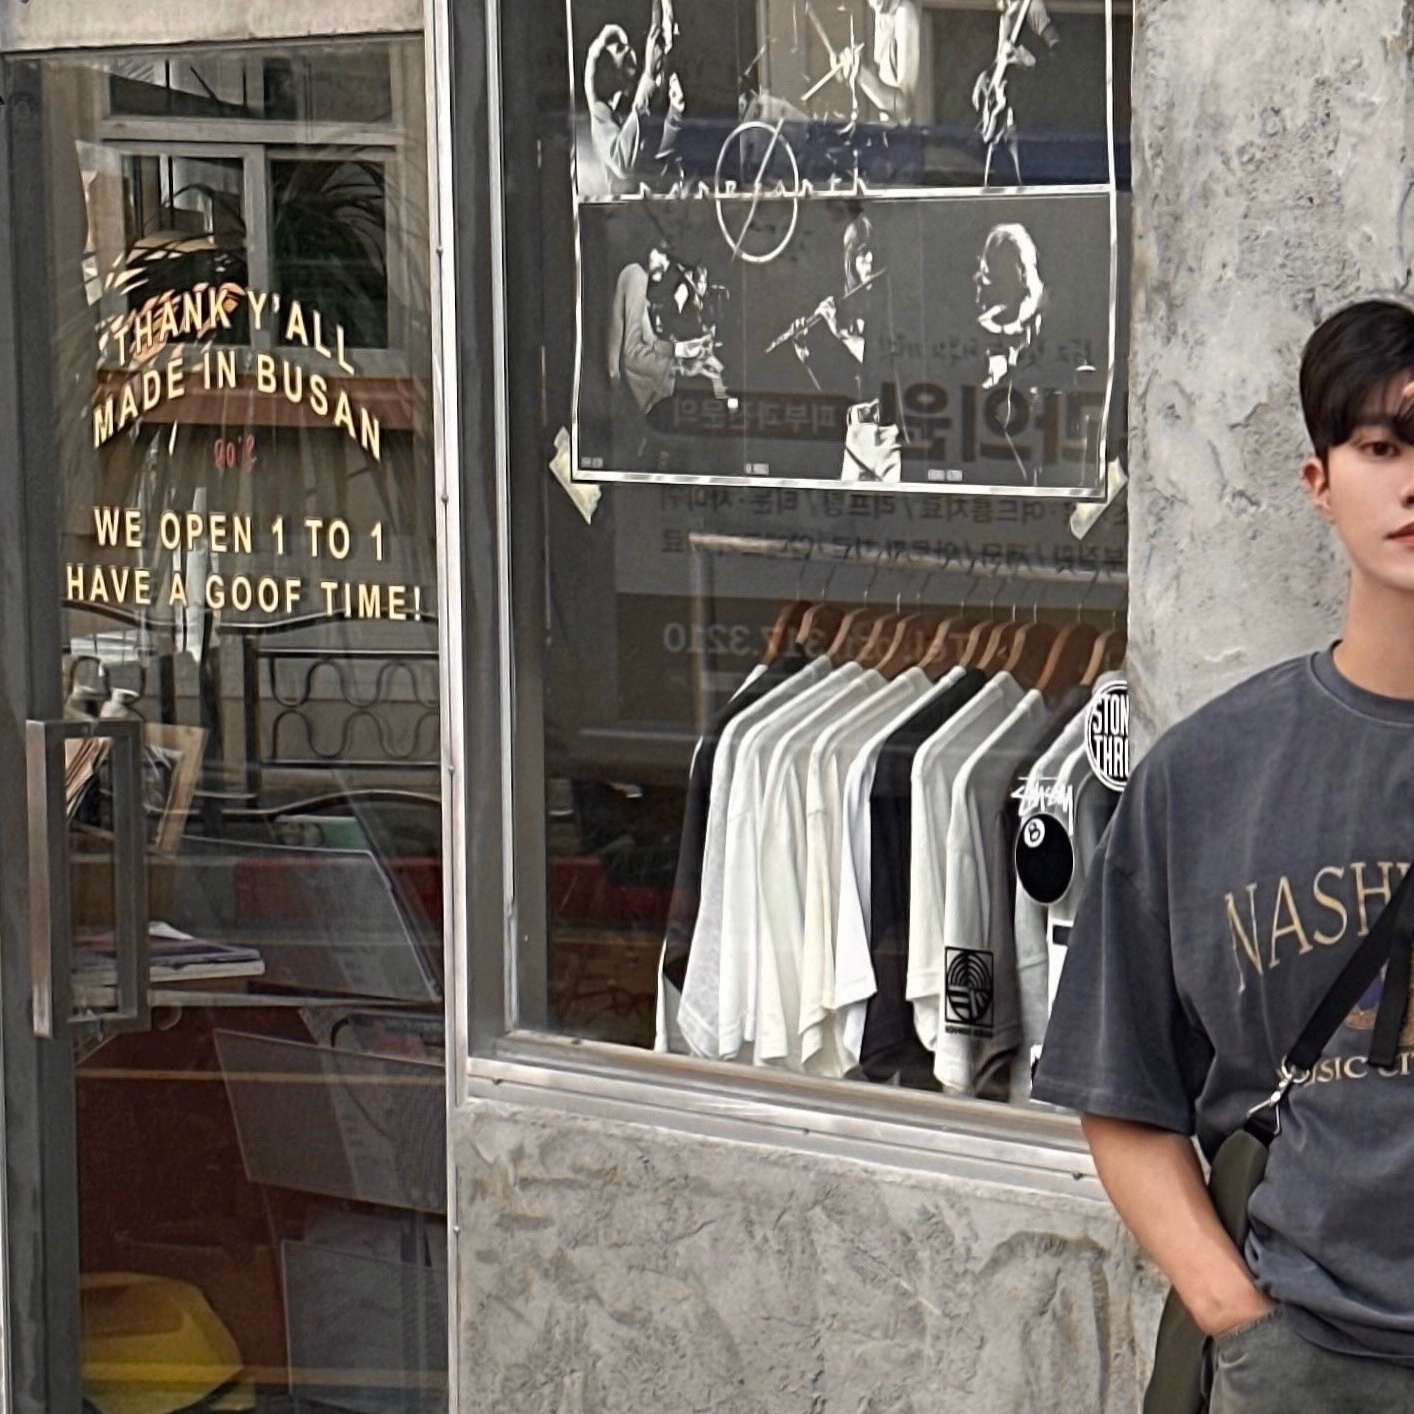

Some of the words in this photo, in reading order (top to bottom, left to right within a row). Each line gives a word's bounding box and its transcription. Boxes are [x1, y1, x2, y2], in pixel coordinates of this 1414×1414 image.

[114, 286, 232, 367] THANK
[247, 290, 355, 376] Y'ALL
[94, 357, 185, 449] MADE
[204, 350, 237, 390] IN
[257, 352, 381, 462] BUSAN
[94, 508, 142, 548] WE
[160, 512, 253, 554] OPEN
[271, 516, 284, 556] 1
[304, 519, 350, 561] TO
[370, 522, 383, 561] 1
[66, 565, 151, 605] HAVE
[168, 572, 188, 606] A
[206, 575, 301, 615] GOOF
[320, 581, 421, 622] TIME!
[1028, 821, 1041, 843] 8
